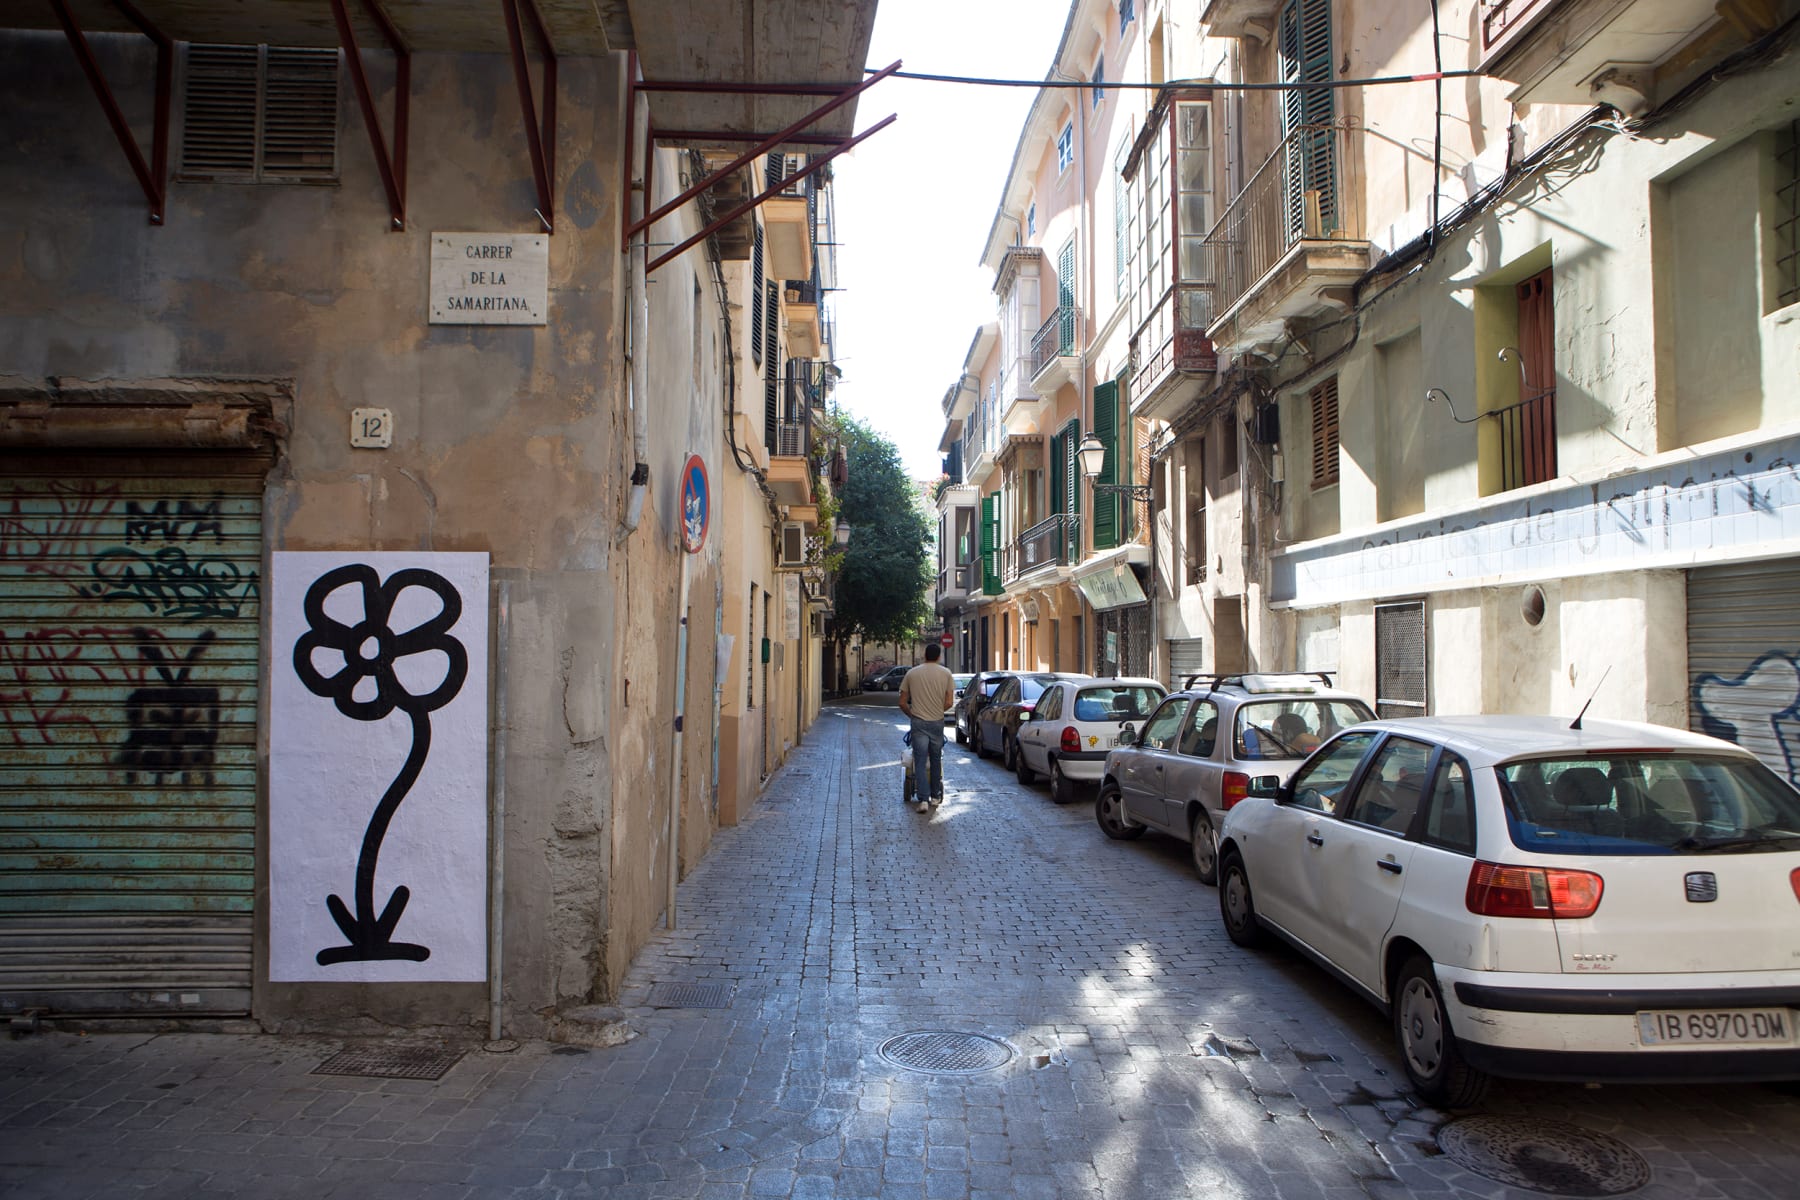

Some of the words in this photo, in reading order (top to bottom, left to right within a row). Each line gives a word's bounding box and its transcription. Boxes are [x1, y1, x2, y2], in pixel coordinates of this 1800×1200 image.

[466, 245, 513, 259] CARRER
[471, 271, 486, 285] DE
[490, 271, 506, 285] LA
[447, 297, 528, 311] SAMARITANA
[362, 417, 382, 438] 12
[1510, 500, 1556, 548] de
[1572, 953, 1617, 961] SEAT
[1656, 1014, 1682, 1040] IB
